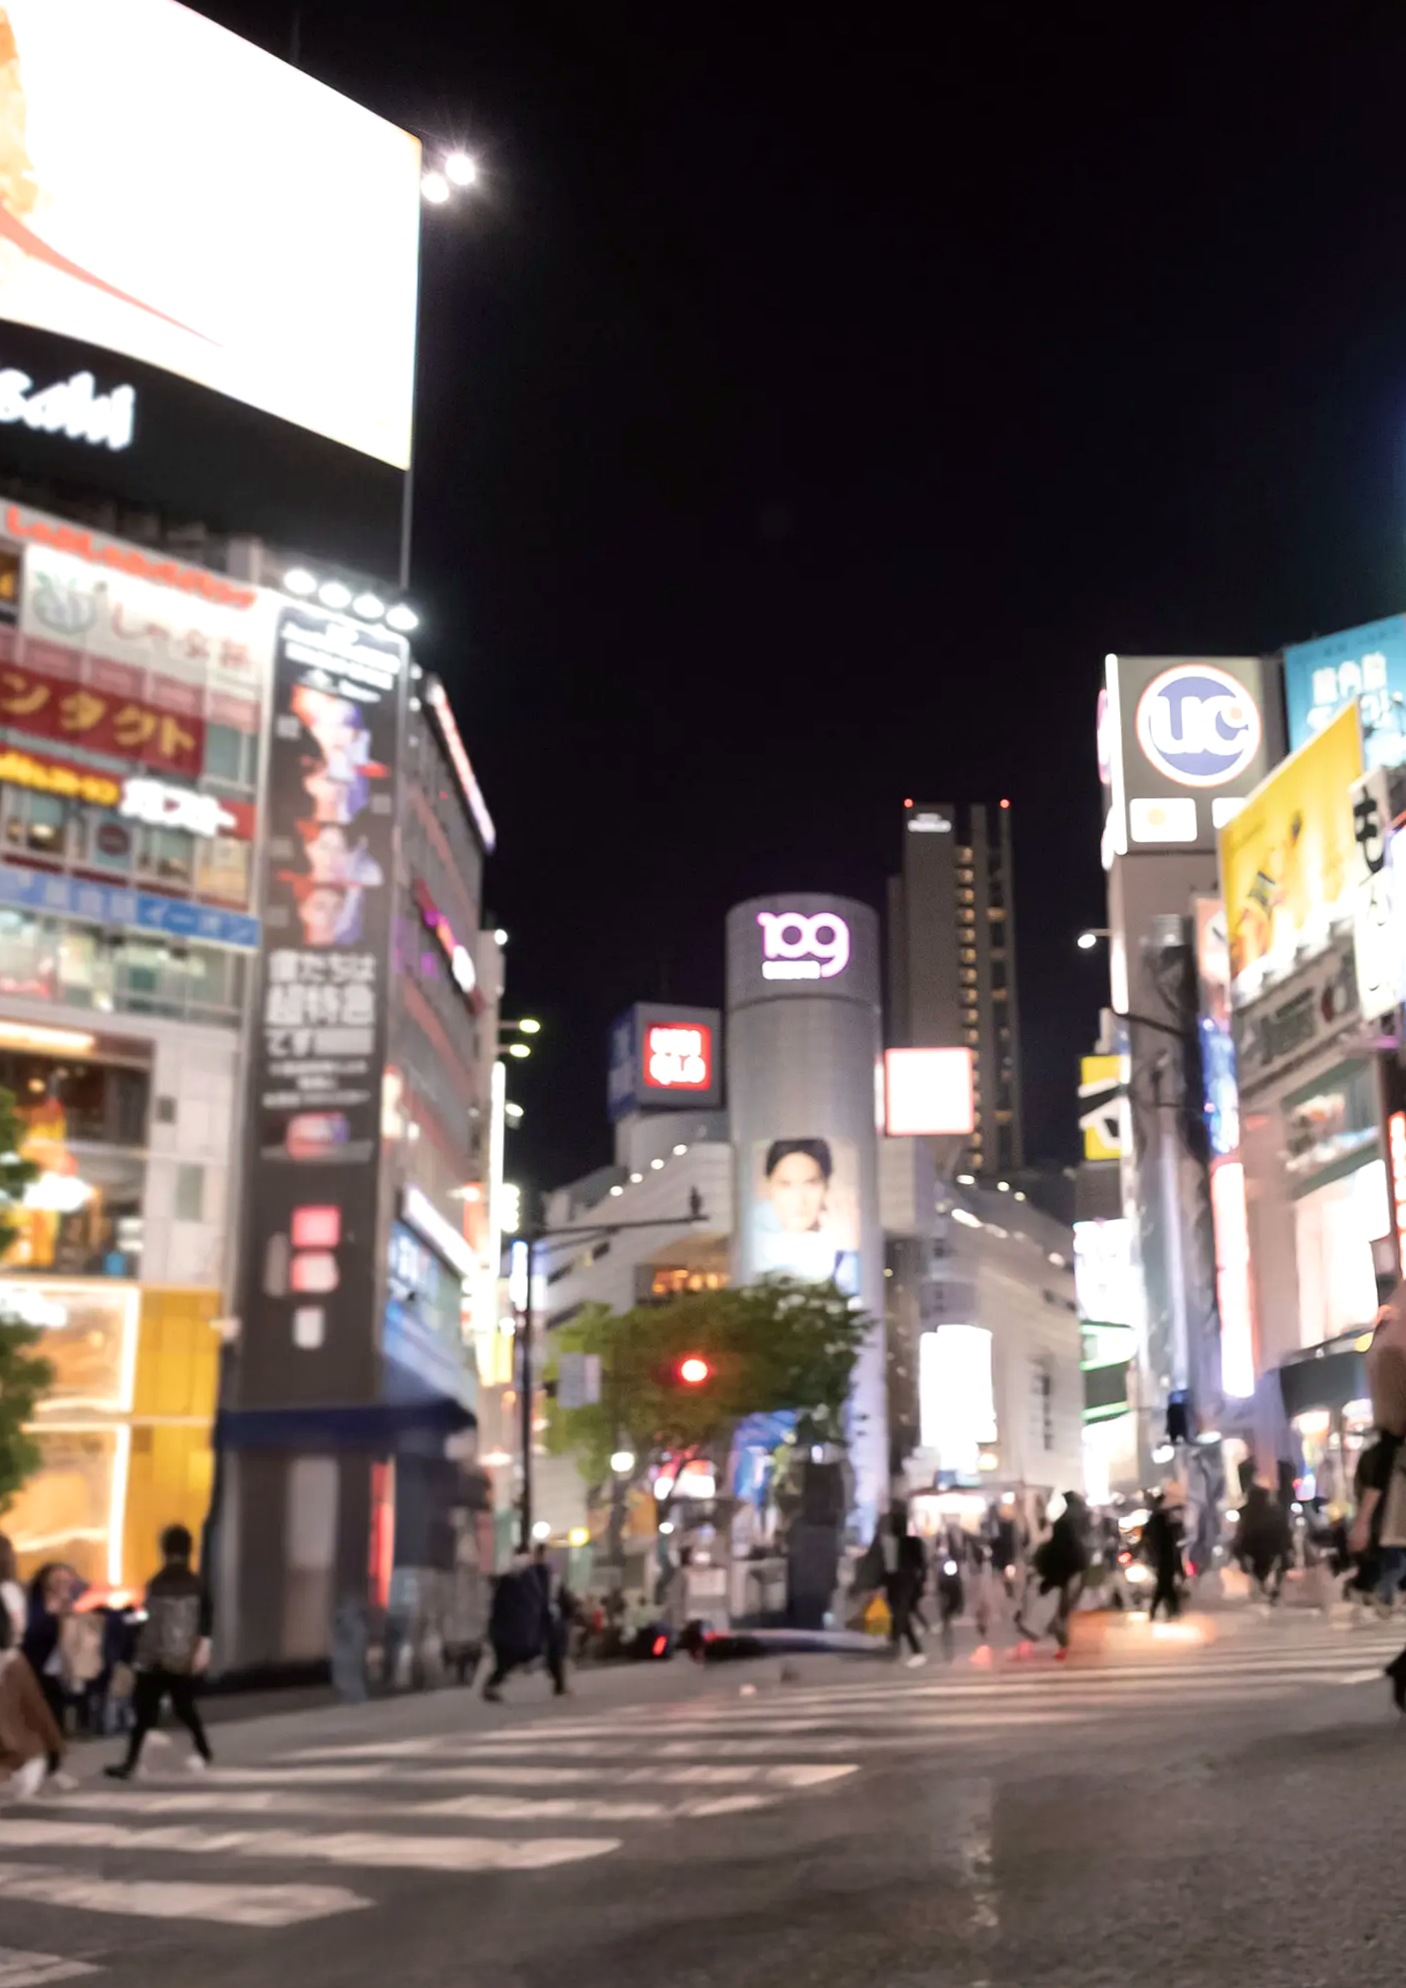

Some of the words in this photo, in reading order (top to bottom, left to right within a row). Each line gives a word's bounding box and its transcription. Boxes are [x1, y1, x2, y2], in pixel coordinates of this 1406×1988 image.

[0, 672, 196, 757] ンタクト
[757, 912, 850, 978] 109
